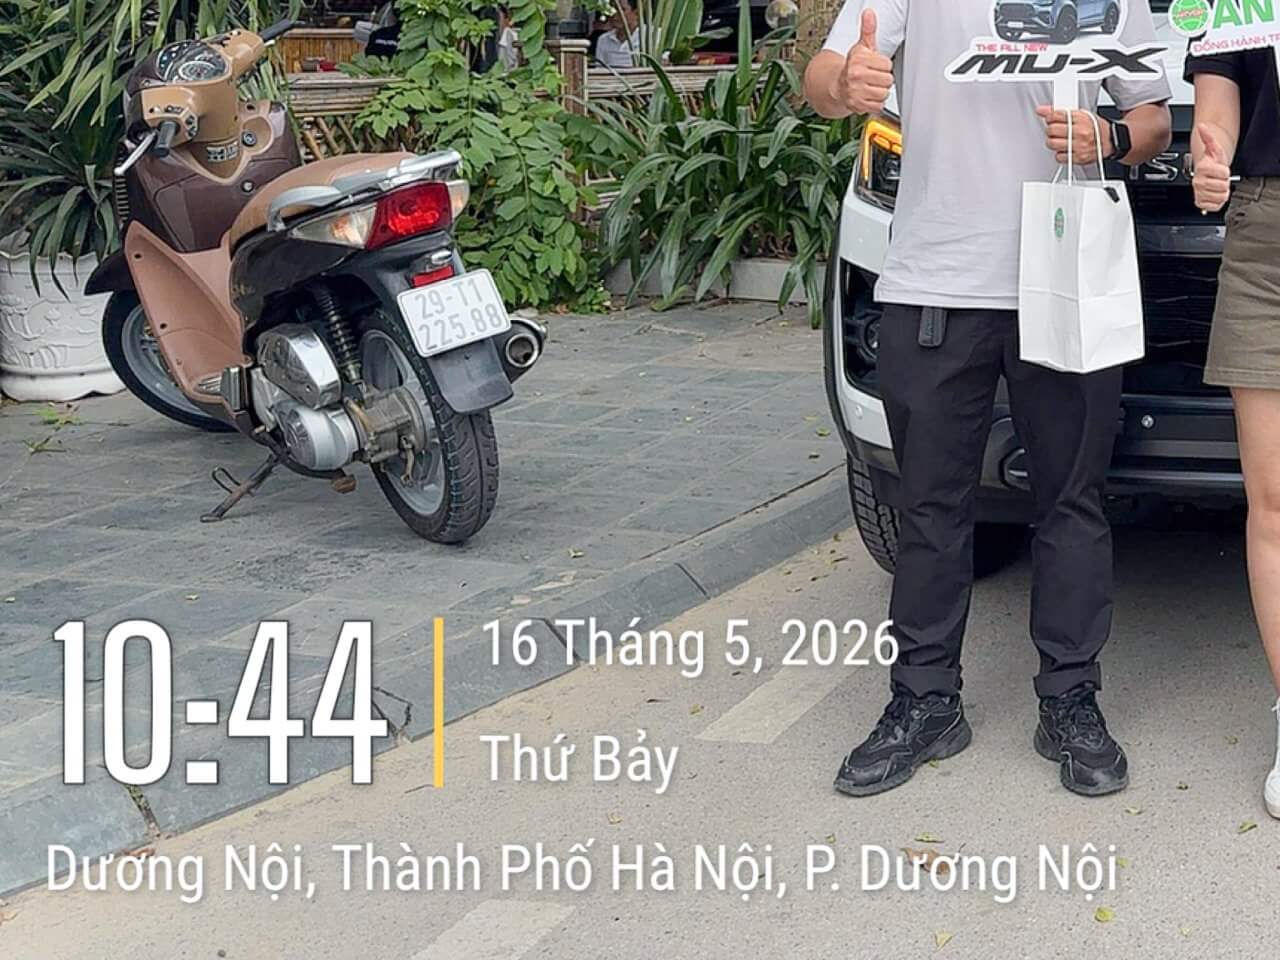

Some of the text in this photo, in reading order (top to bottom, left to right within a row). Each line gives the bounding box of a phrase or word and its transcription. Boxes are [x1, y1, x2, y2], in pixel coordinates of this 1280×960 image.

[951, 47, 1168, 75] MU-X
[976, 43, 1049, 52] THE ALL NEW
[415, 278, 482, 320] 29-T1
[419, 303, 502, 350] 225.88
